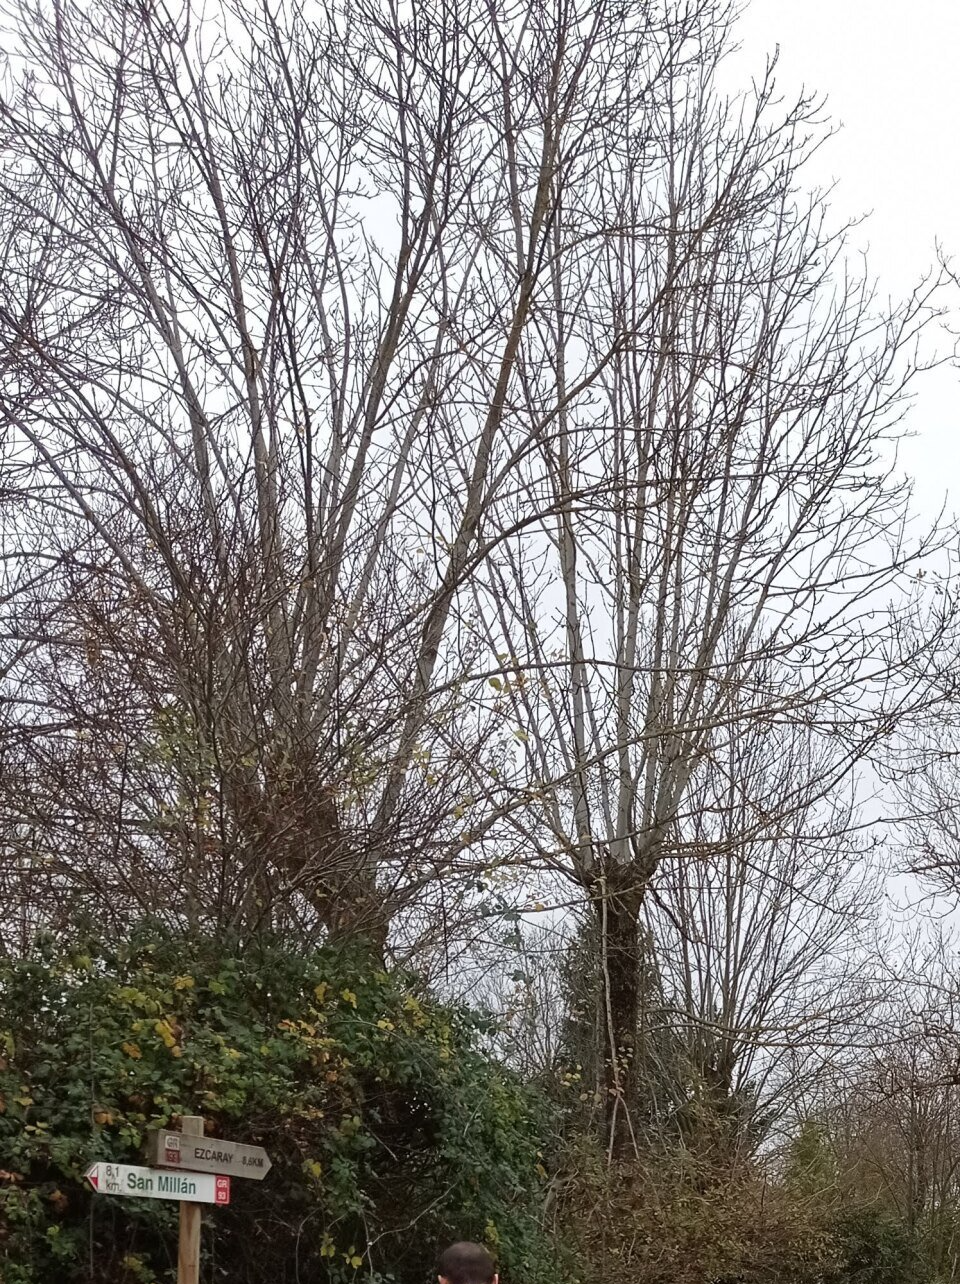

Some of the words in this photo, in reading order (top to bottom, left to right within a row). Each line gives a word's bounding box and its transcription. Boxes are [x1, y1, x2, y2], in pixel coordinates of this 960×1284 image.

[195, 1148, 234, 1163] EZCARAY
[106, 1165, 119, 1178] 8,1
[127, 1172, 153, 1190] San
[158, 1176, 196, 1194] Millán
[217, 1179, 227, 1188] GR
[218, 1191, 226, 1200] 93
